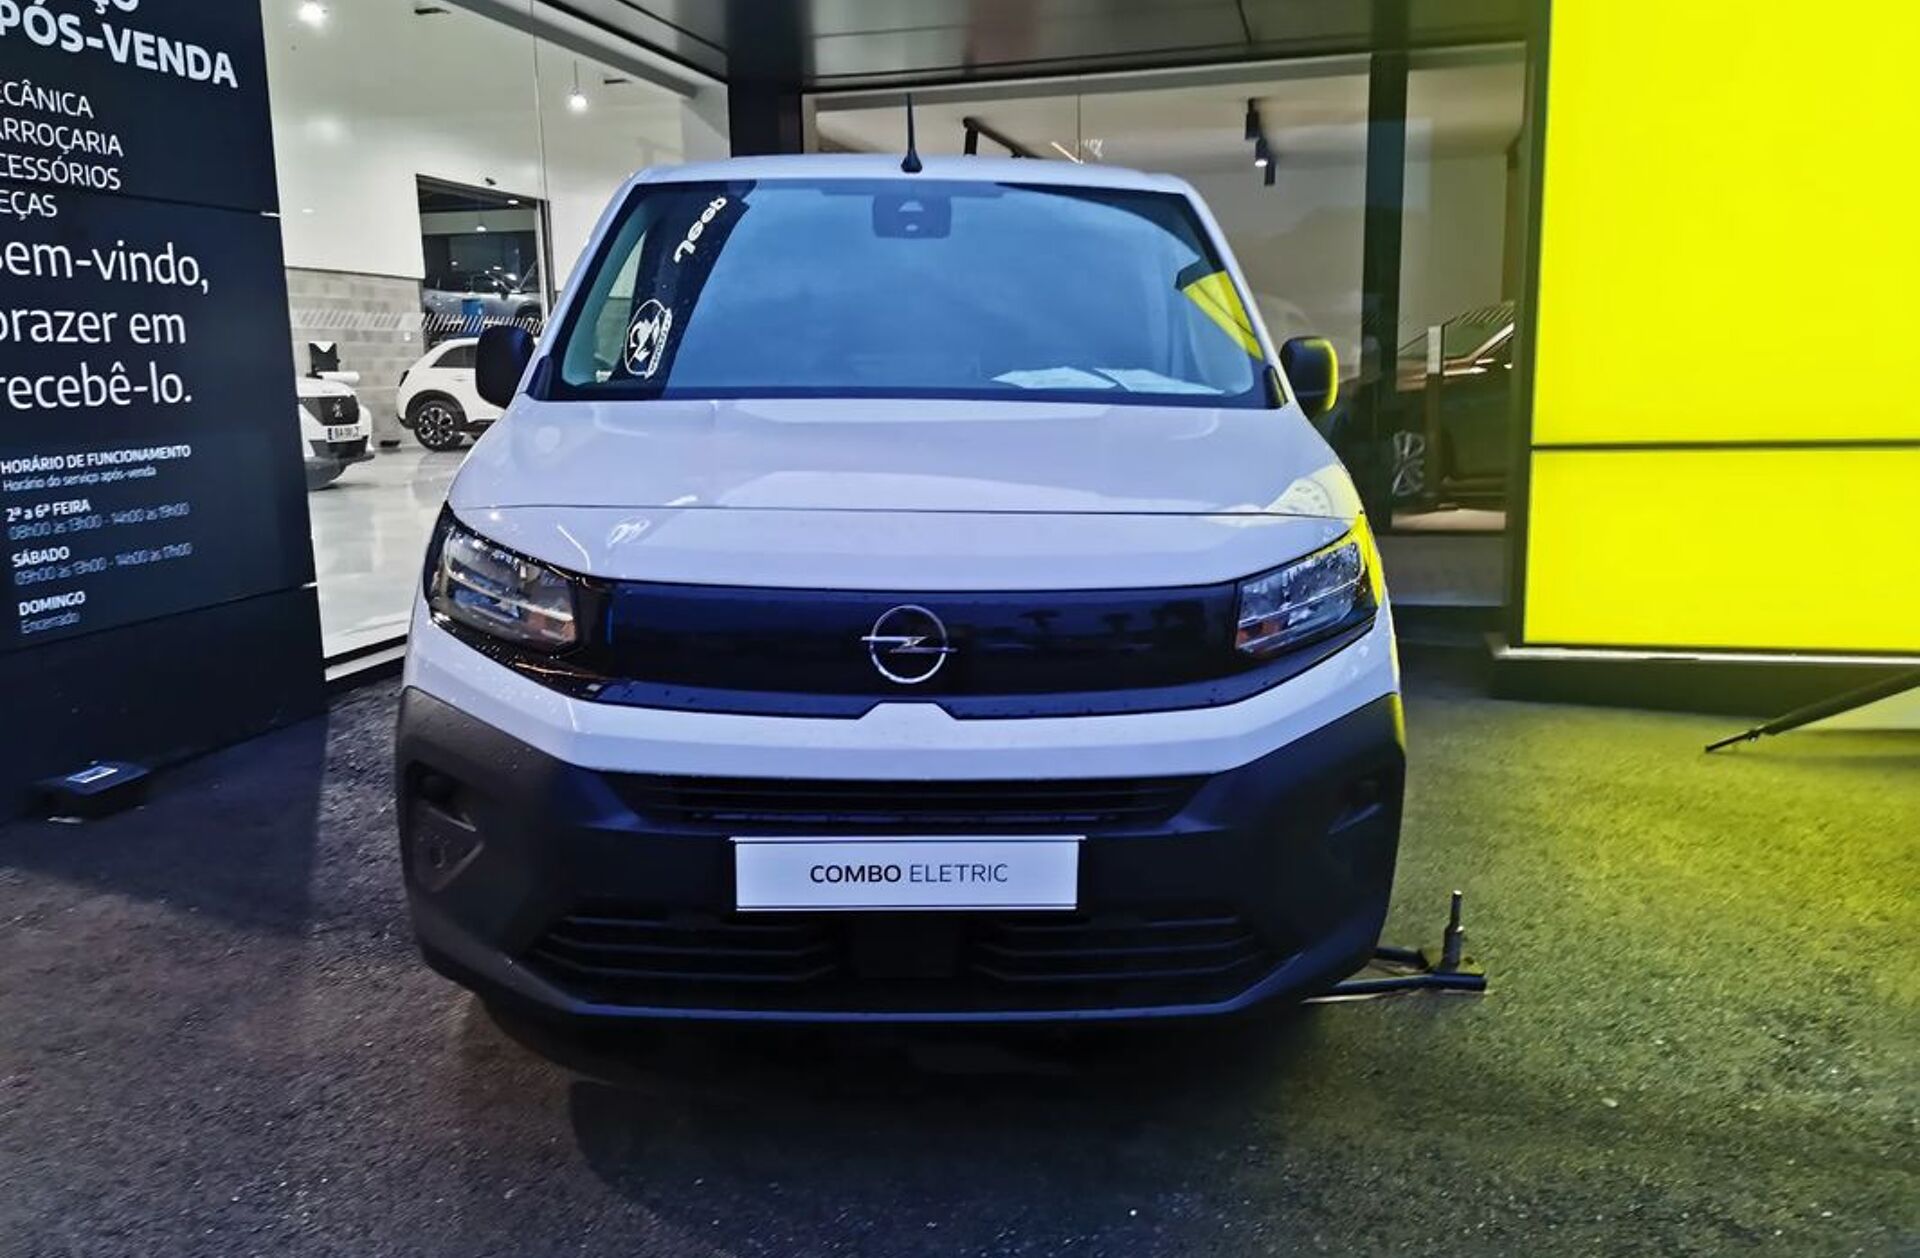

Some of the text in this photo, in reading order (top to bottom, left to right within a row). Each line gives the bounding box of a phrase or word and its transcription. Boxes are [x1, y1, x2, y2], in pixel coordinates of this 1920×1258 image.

[0, 0, 239, 88] PÓS-VENDA
[0, 79, 95, 118] CÂNICA
[0, 117, 124, 157] RROÇARIA
[0, 240, 209, 294] em-vindo,
[129, 312, 186, 344] em
[1, 445, 192, 475] HORÁRIO DE FUNCIONAMENTO
[3, 476, 44, 491] Horário
[47, 474, 61, 488] do
[62, 470, 99, 486] serviço
[23, 508, 33, 520] a
[52, 499, 91, 517] FEIRA
[11, 546, 70, 568] SÁBADO
[19, 590, 86, 616] DOMINGO
[809, 863, 1009, 884] COMBO ELETRIC
